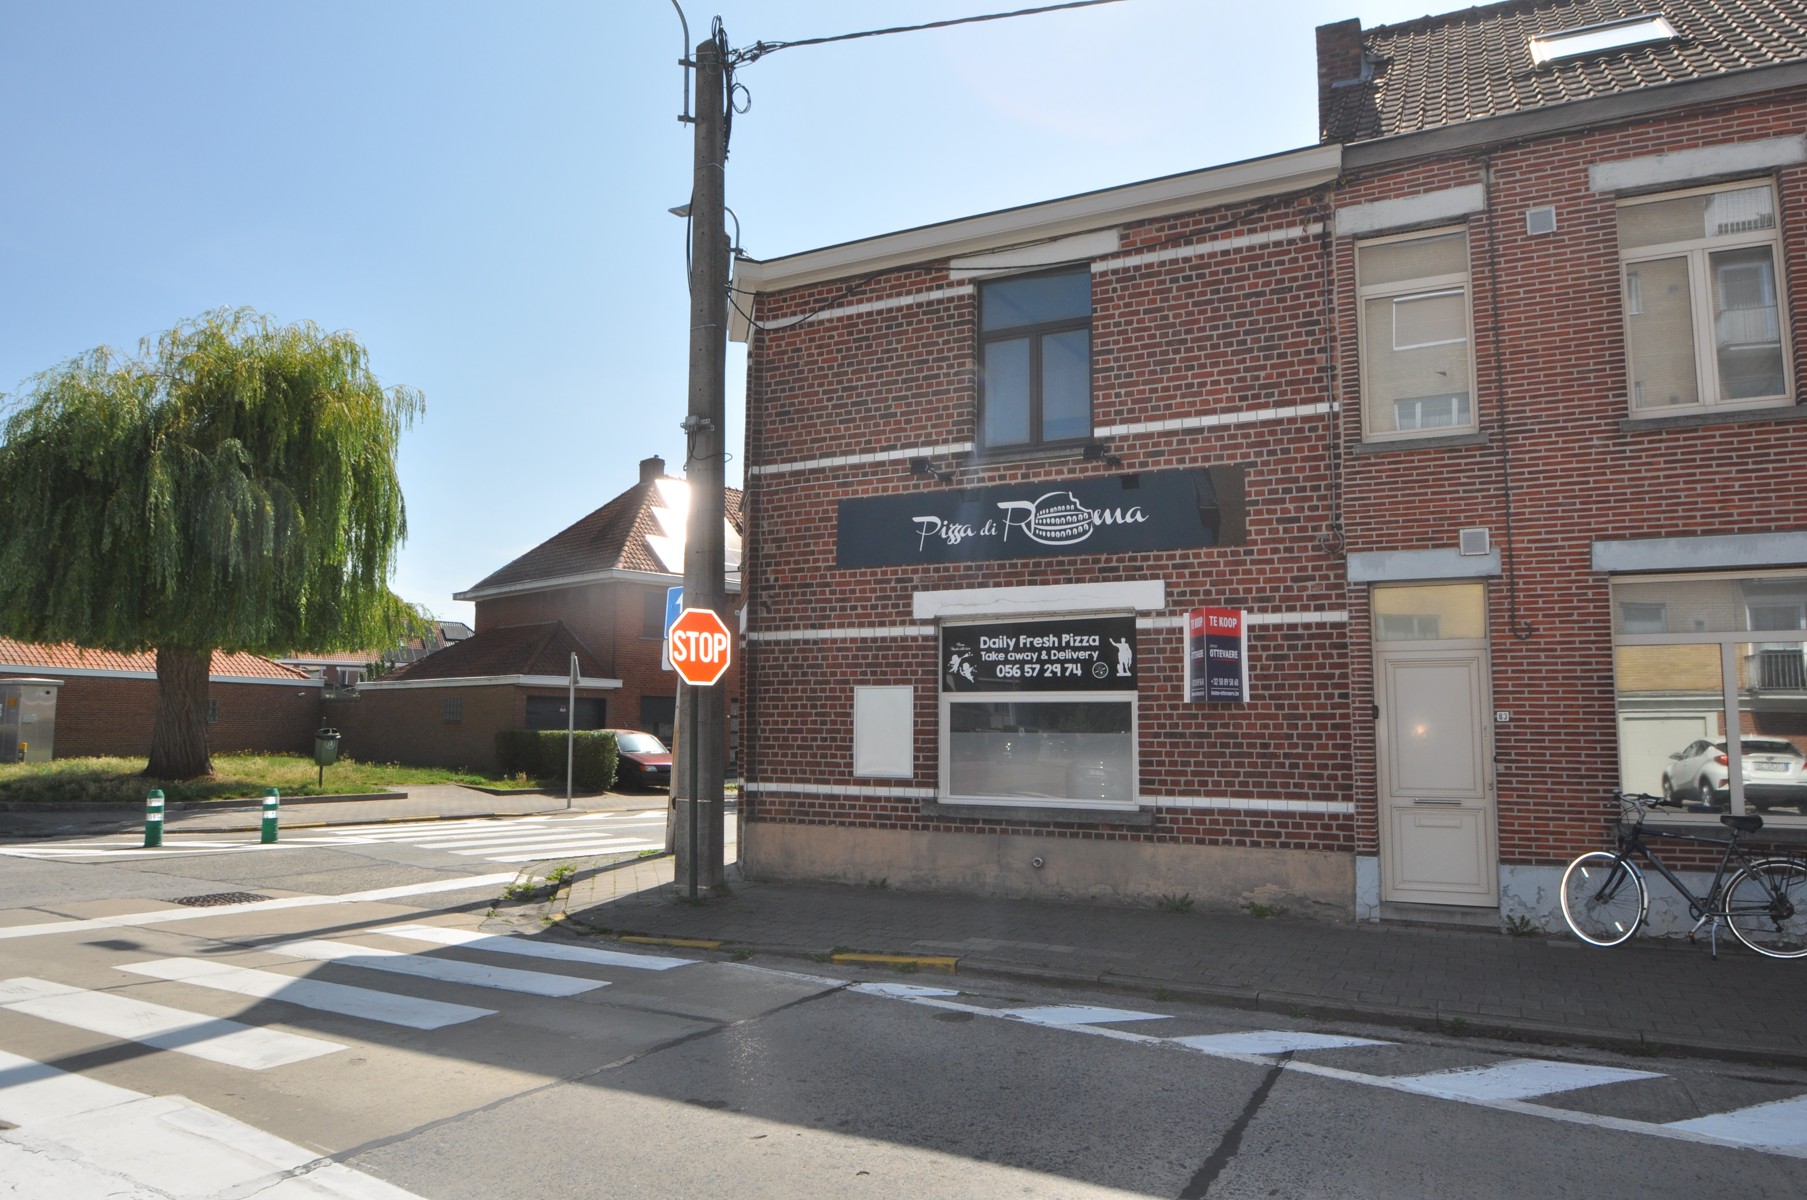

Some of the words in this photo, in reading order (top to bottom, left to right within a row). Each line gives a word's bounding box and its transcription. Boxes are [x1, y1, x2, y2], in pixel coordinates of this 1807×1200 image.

[912, 516, 976, 552] Pizza
[980, 519, 998, 536] di
[997, 491, 1149, 546] Roma
[1209, 615, 1218, 627] TE
[1219, 617, 1238, 629] KOOP
[673, 630, 727, 663] STOP
[979, 636, 1016, 650] Daily
[1019, 634, 1058, 648] Fresh
[1061, 633, 1100, 647] Pizza
[980, 650, 1005, 661] Take
[1007, 651, 1038, 662] away
[1040, 650, 1048, 660] &
[1050, 649, 1099, 662] Delivery
[996, 664, 1021, 677] 056
[1024, 664, 1040, 677] 57
[1043, 664, 1061, 677] 29
[1064, 663, 1082, 677] 74
